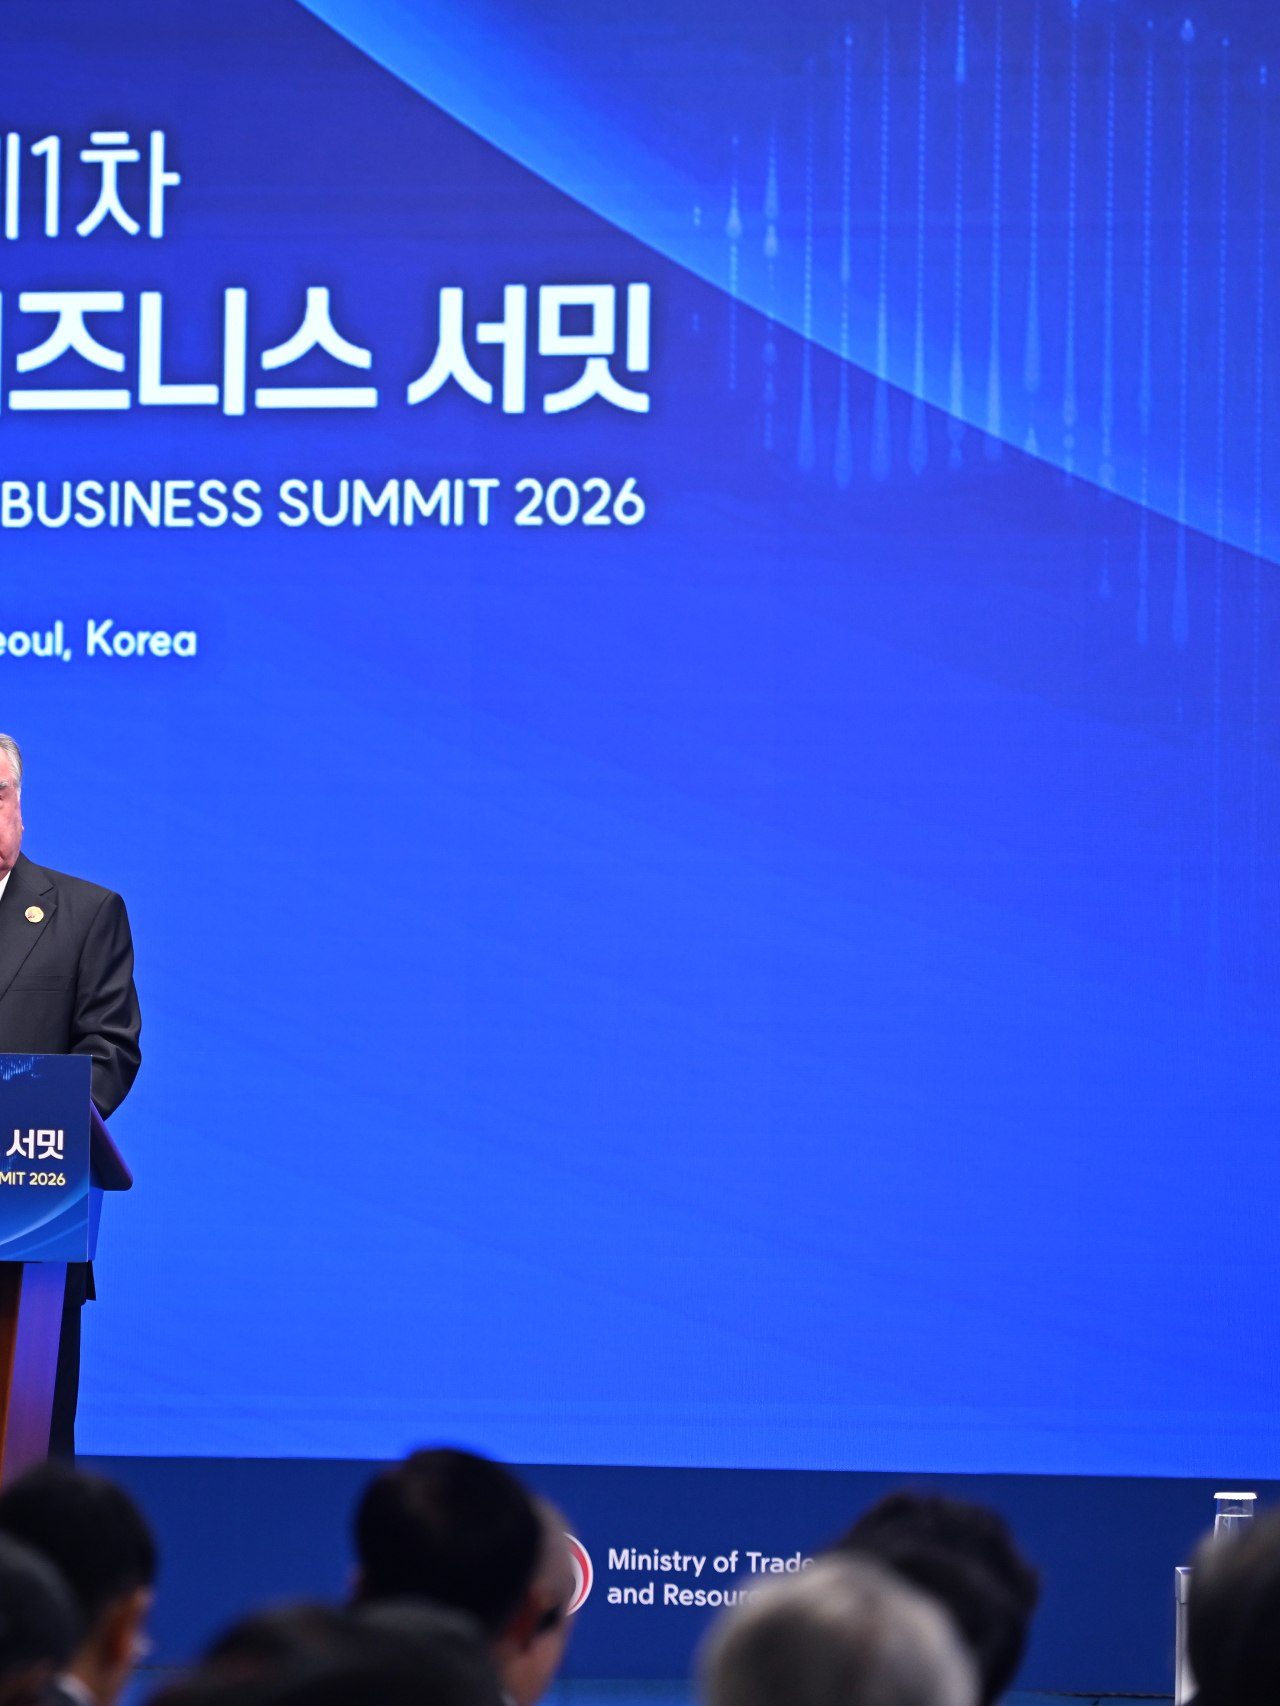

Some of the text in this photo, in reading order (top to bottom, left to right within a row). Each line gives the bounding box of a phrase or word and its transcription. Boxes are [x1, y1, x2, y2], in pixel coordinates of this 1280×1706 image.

[407, 283, 651, 414] 서밋
[1, 479, 262, 528] BUSINESS
[278, 478, 500, 527] SUMMIT
[514, 477, 646, 526] 2026
[86, 619, 197, 657] Korea
[6, 1129, 65, 1160] 서밋
[29, 1171, 66, 1187] 2026
[608, 1547, 707, 1578] Ministry
[712, 1550, 739, 1573] of
[607, 1582, 761, 1607] and Resour
